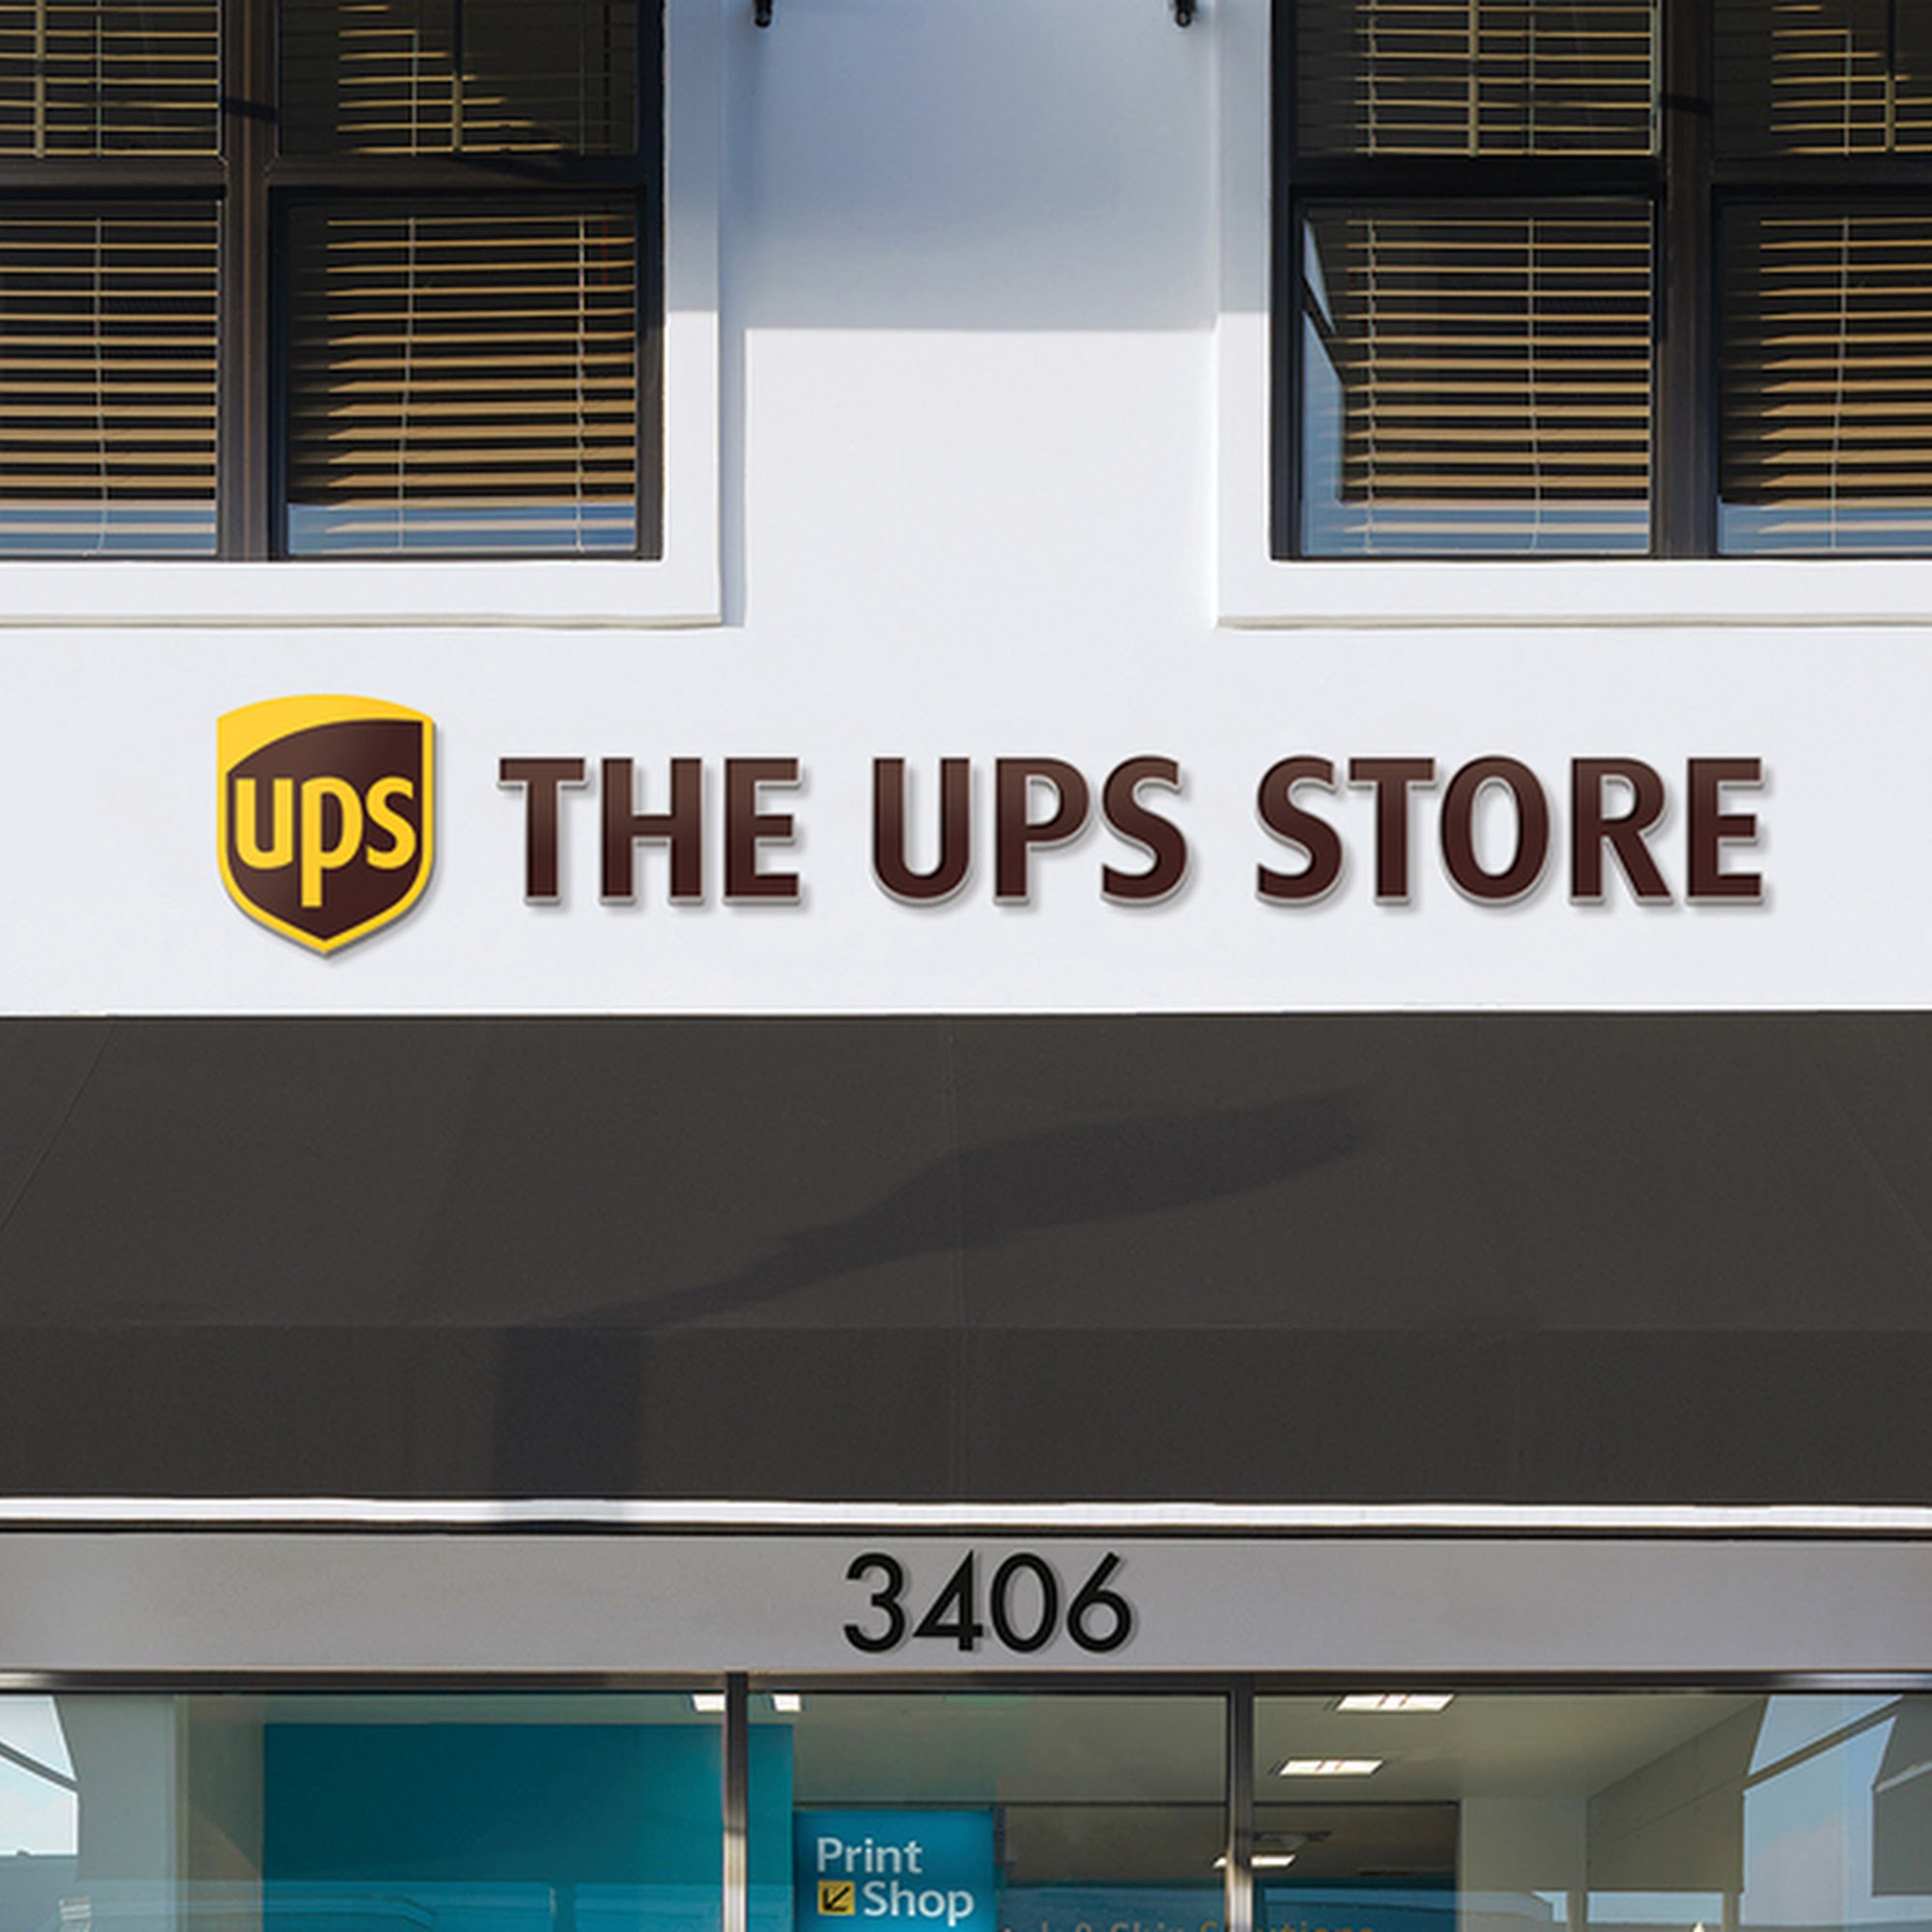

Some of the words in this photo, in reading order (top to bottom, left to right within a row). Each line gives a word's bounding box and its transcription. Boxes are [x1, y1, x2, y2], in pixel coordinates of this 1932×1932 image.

[235, 777, 417, 908] ups
[498, 756, 801, 904] THE
[871, 754, 1190, 906] UPS
[1256, 754, 1765, 906] STORE
[843, 1549, 1132, 1653] 3406
[817, 1836, 923, 1873] Print
[863, 1880, 975, 1927] Shop
